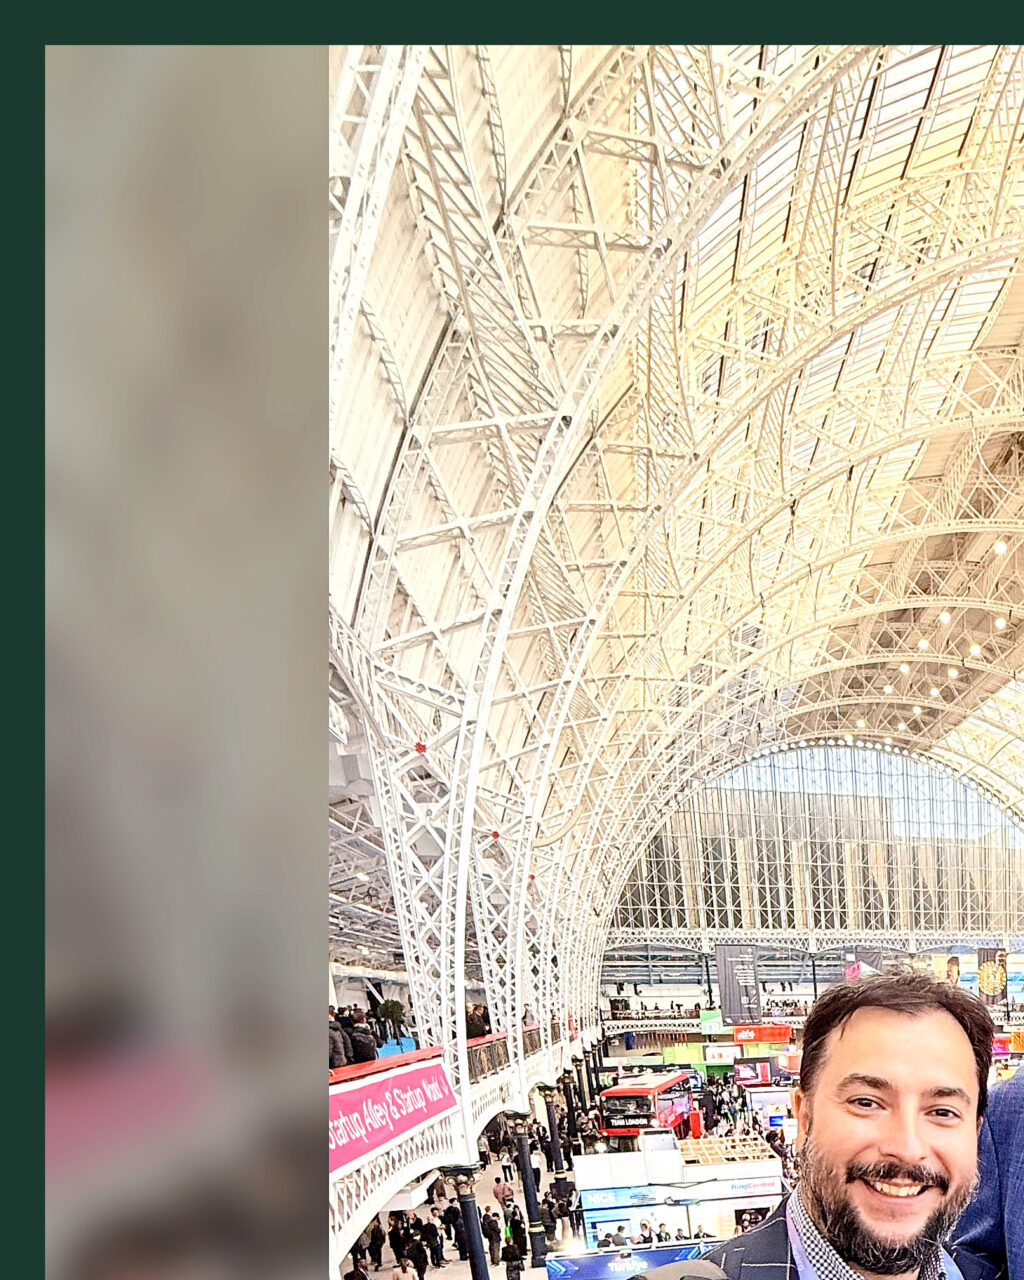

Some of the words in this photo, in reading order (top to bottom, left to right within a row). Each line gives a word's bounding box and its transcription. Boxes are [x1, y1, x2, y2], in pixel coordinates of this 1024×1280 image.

[362, 1098, 394, 1131] Alley
[385, 1091, 401, 1120] &
[393, 1086, 428, 1117] Startup
[626, 1117, 648, 1126] LONDON
